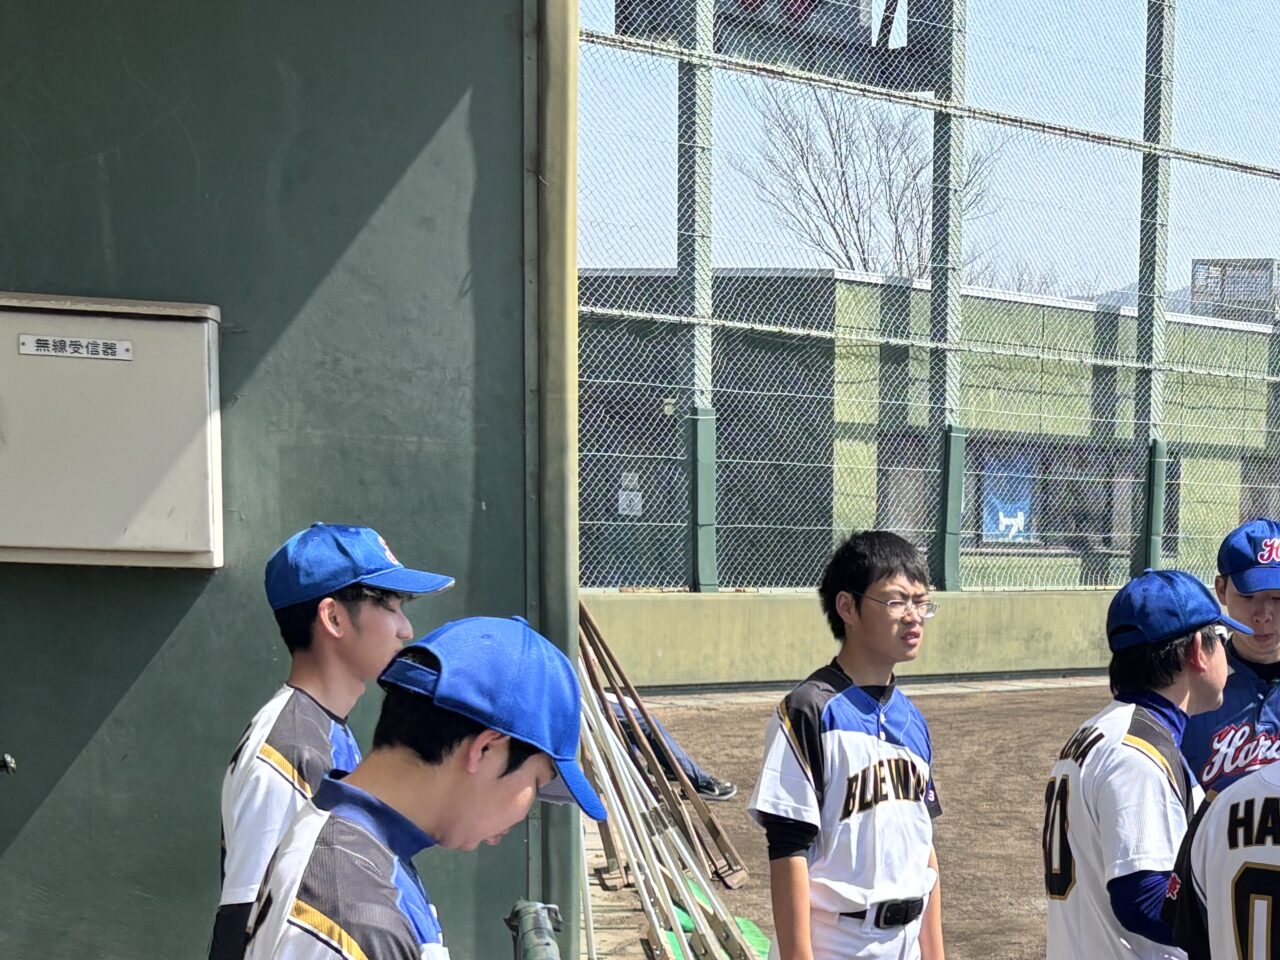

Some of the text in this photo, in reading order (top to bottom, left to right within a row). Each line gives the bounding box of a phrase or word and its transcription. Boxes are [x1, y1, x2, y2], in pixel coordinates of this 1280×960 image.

[35, 338, 118, 357] 無線受信器
